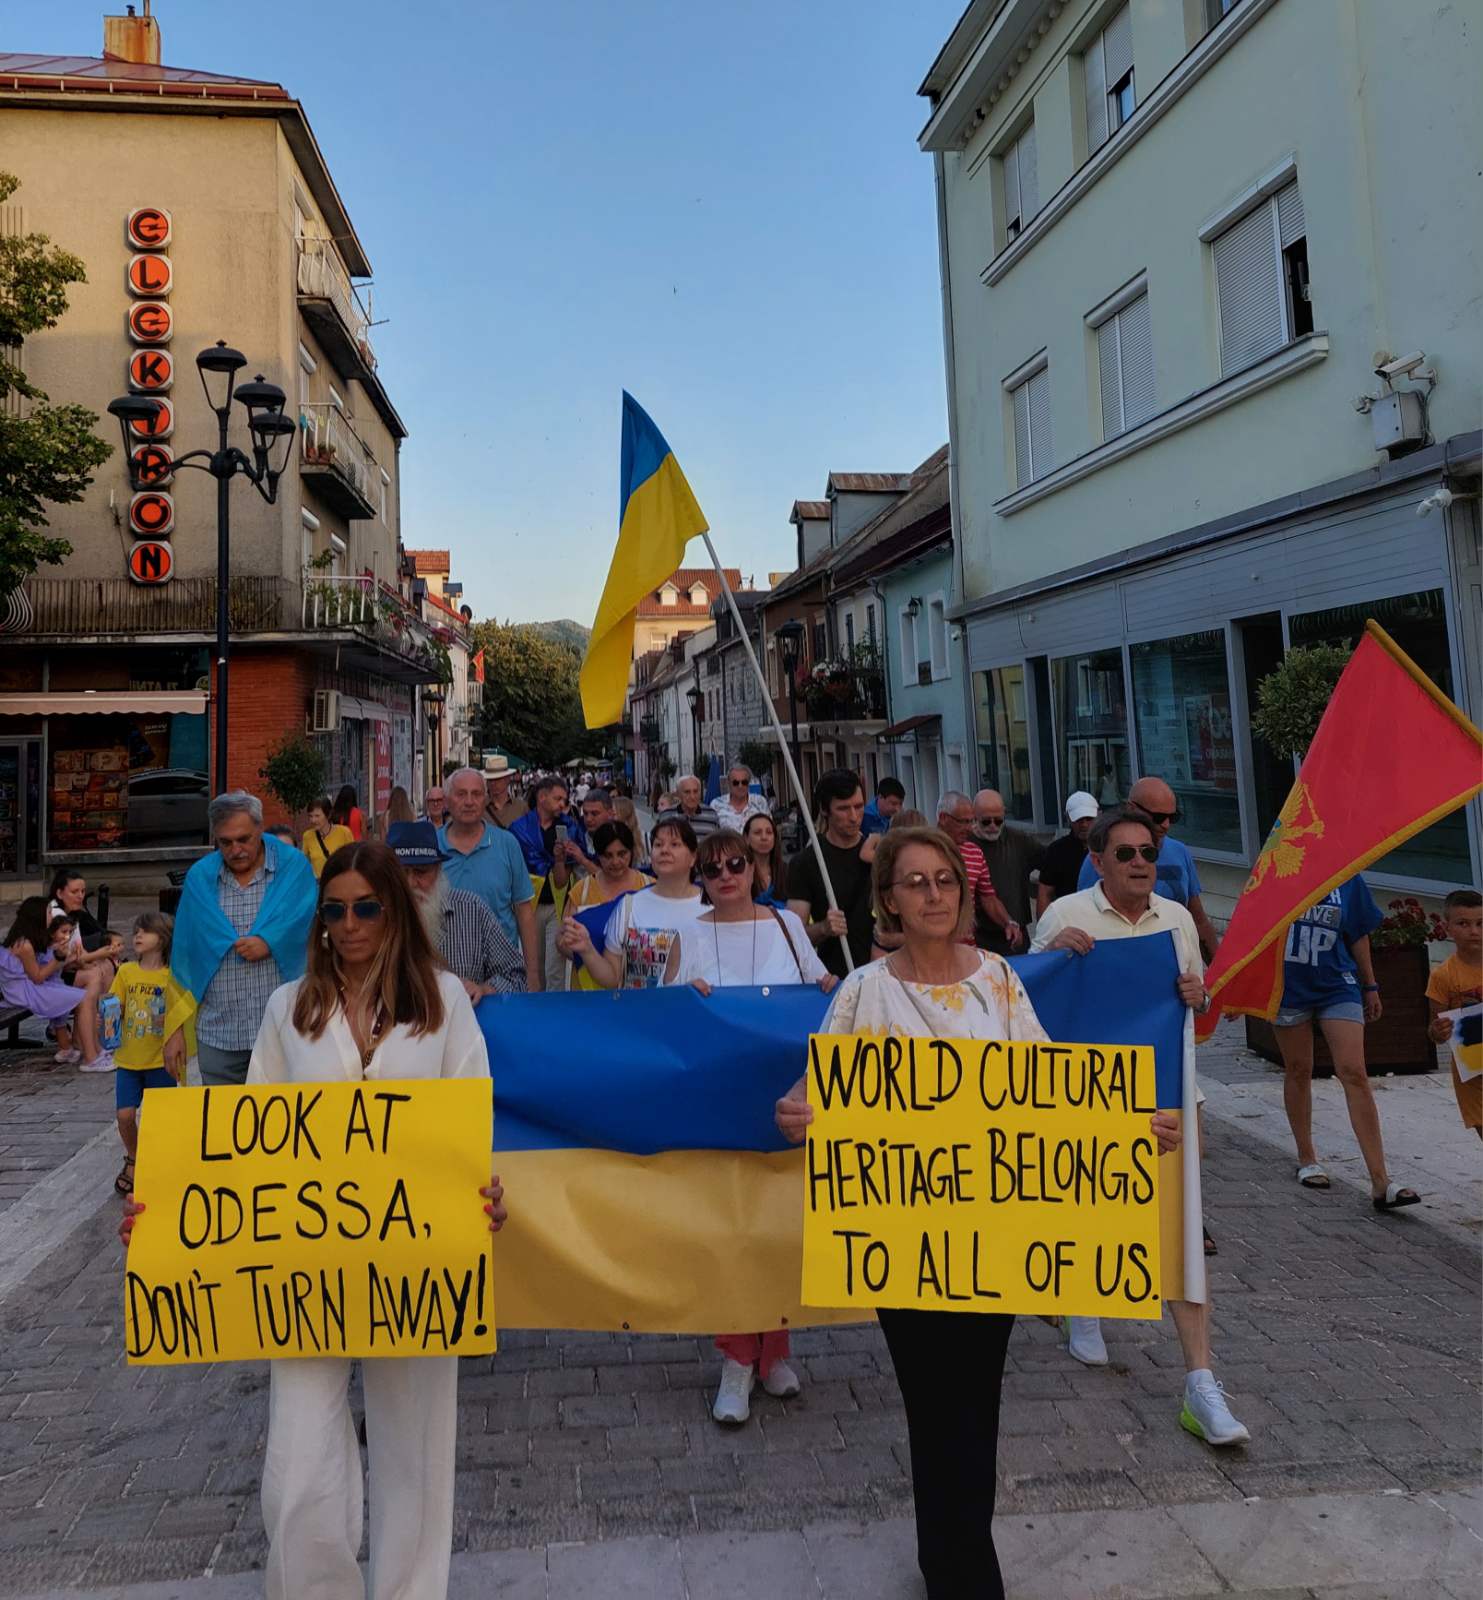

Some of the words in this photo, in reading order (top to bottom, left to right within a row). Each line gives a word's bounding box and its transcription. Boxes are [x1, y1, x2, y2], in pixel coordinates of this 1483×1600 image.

[1283, 922, 1337, 967] UP
[810, 1036, 963, 1111] WORLD
[979, 1039, 1157, 1114] CULTURAL
[201, 1088, 322, 1161] LOOK
[345, 1088, 411, 1153] AT
[987, 1128, 1154, 1205] BELONGS
[179, 1179, 431, 1250] ODESSA,
[832, 1230, 890, 1295] TO
[917, 1230, 1001, 1300] ALL
[1025, 1241, 1076, 1297] OF
[1095, 1242, 1159, 1303] US.
[126, 1269, 221, 1358] DON'T
[236, 1265, 346, 1352] TURN
[367, 1253, 488, 1350] AWAY!
